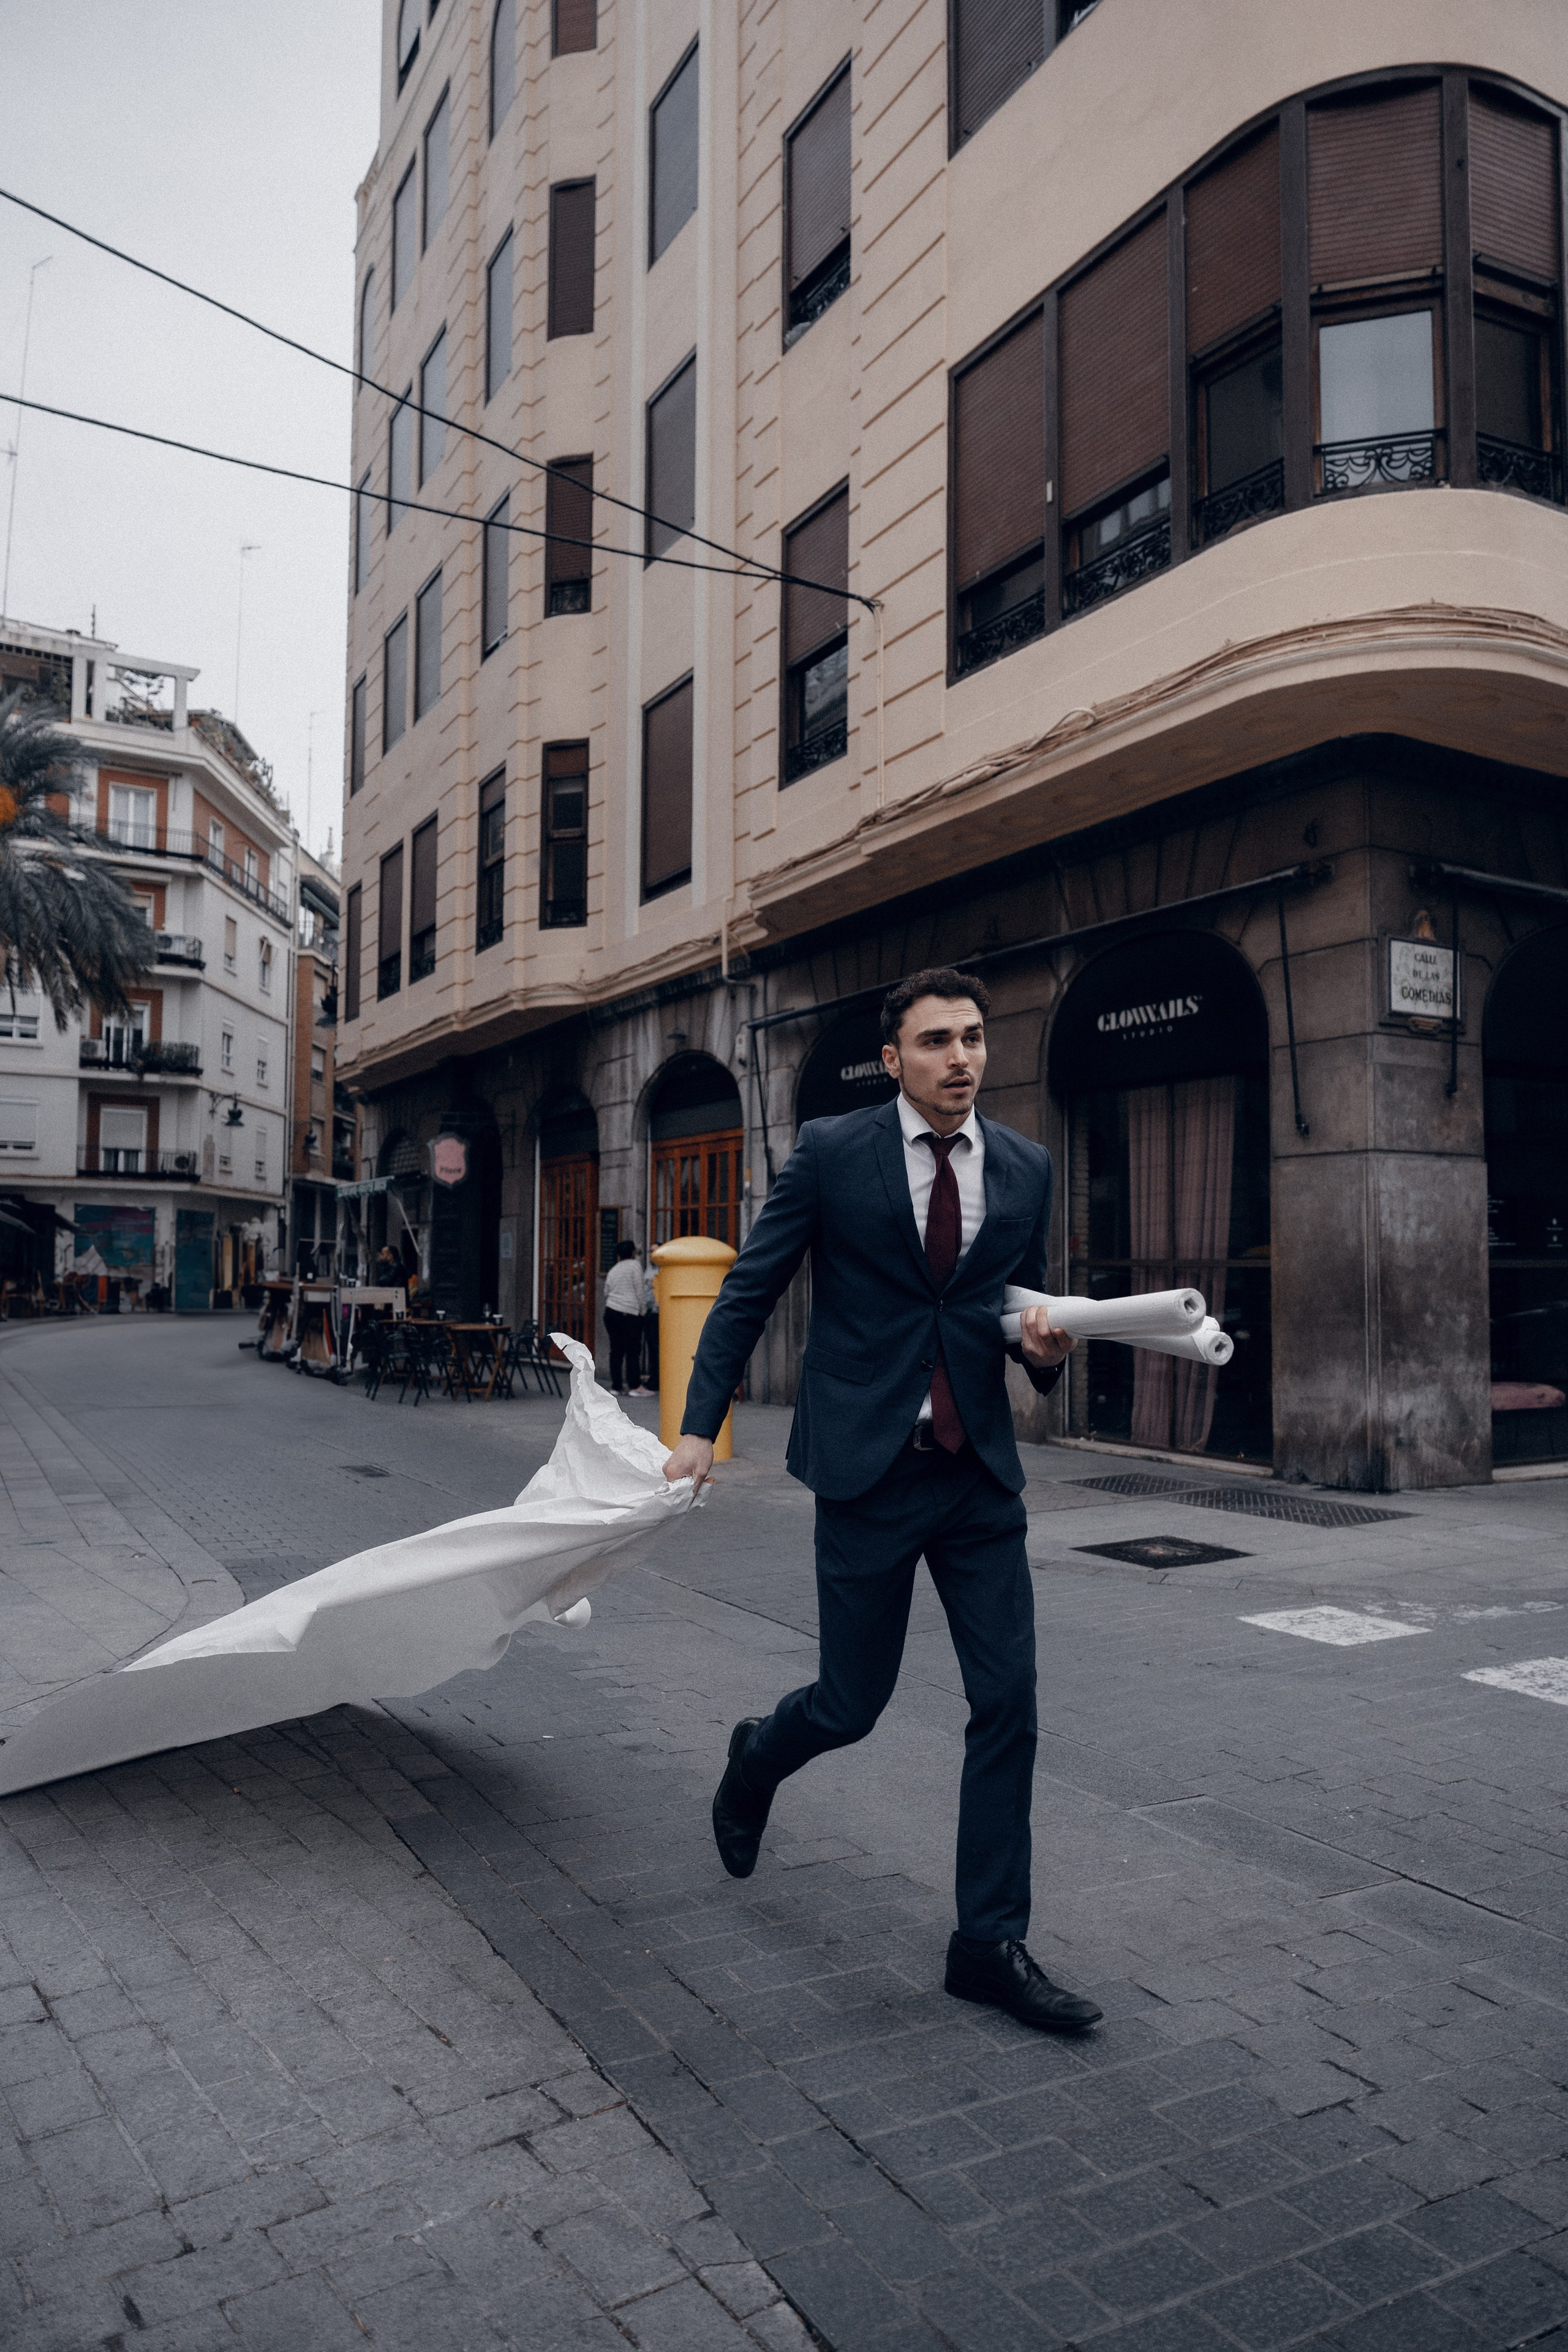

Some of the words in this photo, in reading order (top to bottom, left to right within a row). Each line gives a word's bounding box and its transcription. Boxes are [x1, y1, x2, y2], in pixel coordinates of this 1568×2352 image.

[1414, 952, 1437, 965] CALLE
[1412, 969, 1422, 979] DE
[1425, 971, 1440, 981] LAS
[1401, 986, 1452, 1005] COMEDIAS
